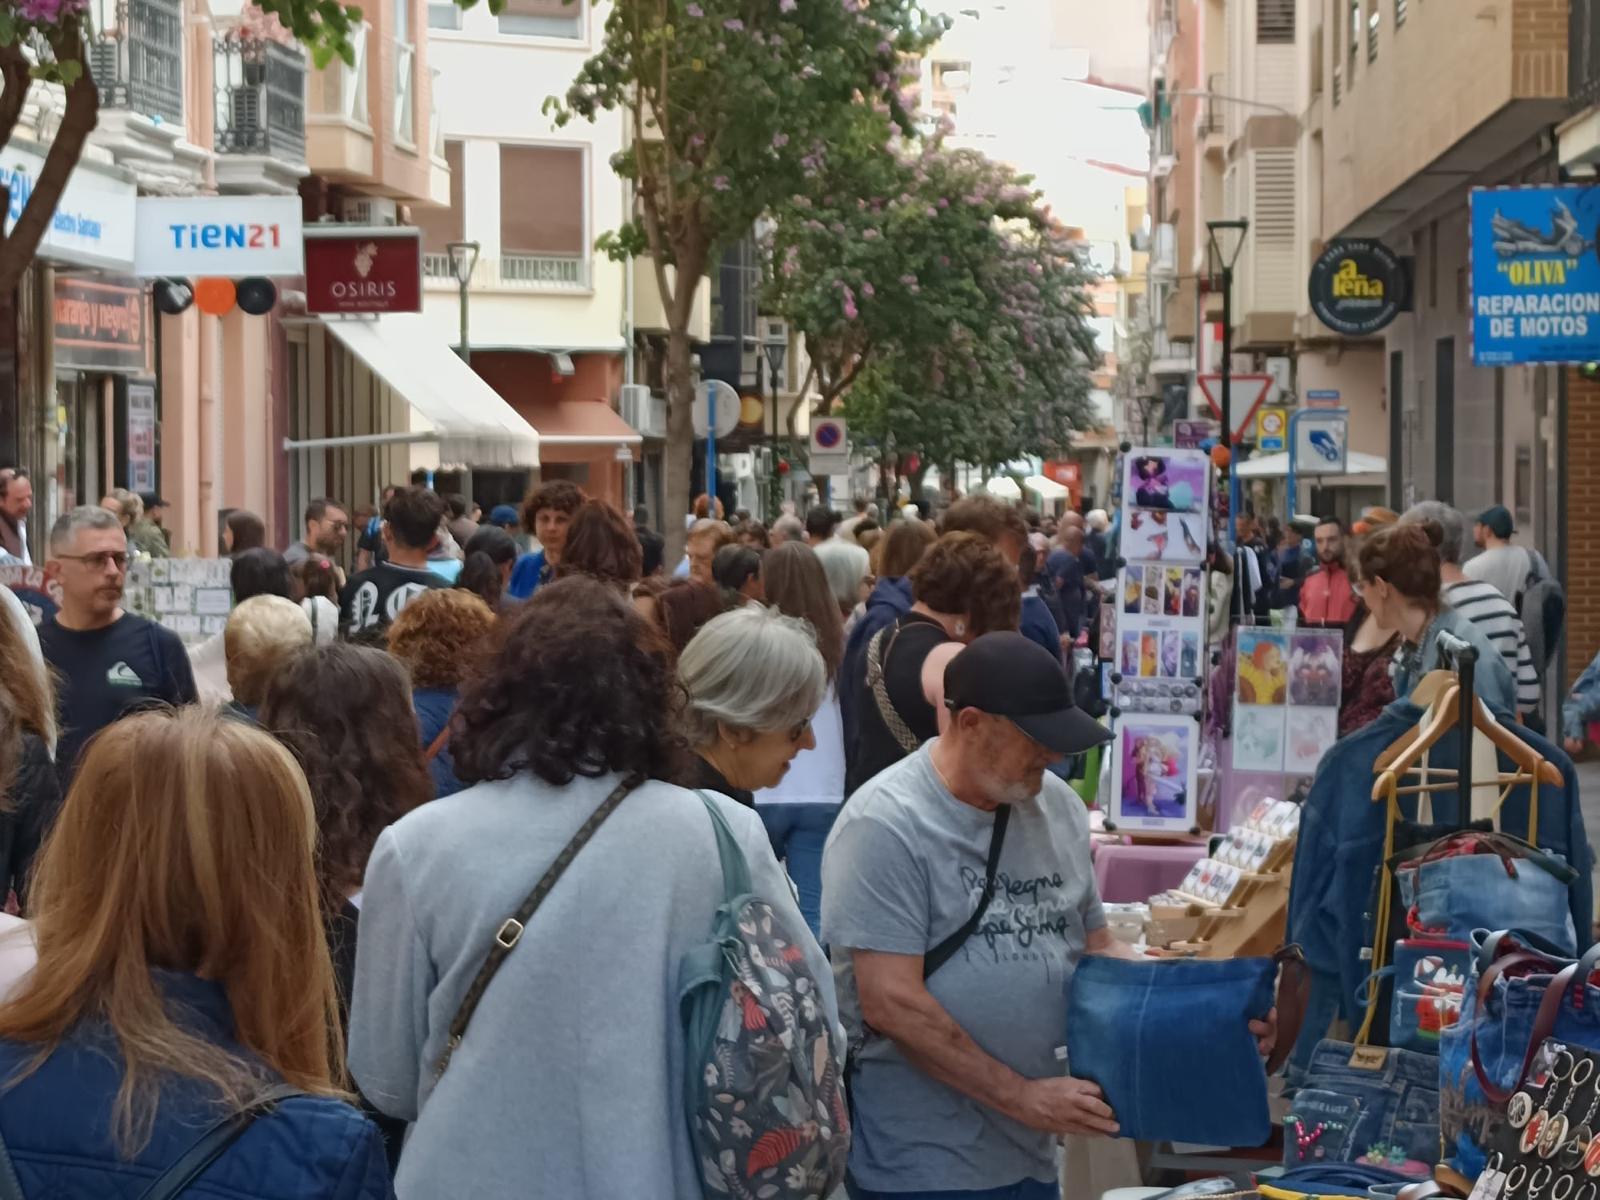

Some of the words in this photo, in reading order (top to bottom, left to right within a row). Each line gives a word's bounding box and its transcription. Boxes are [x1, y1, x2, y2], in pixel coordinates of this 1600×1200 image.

[1339, 259, 1357, 279] a
[331, 281, 397, 298] OSIRIS
[1477, 293, 1600, 315] REPARACION
[91, 303, 99, 337] y
[1490, 318, 1515, 337] DE
[1520, 316, 1588, 337] MOTOS
